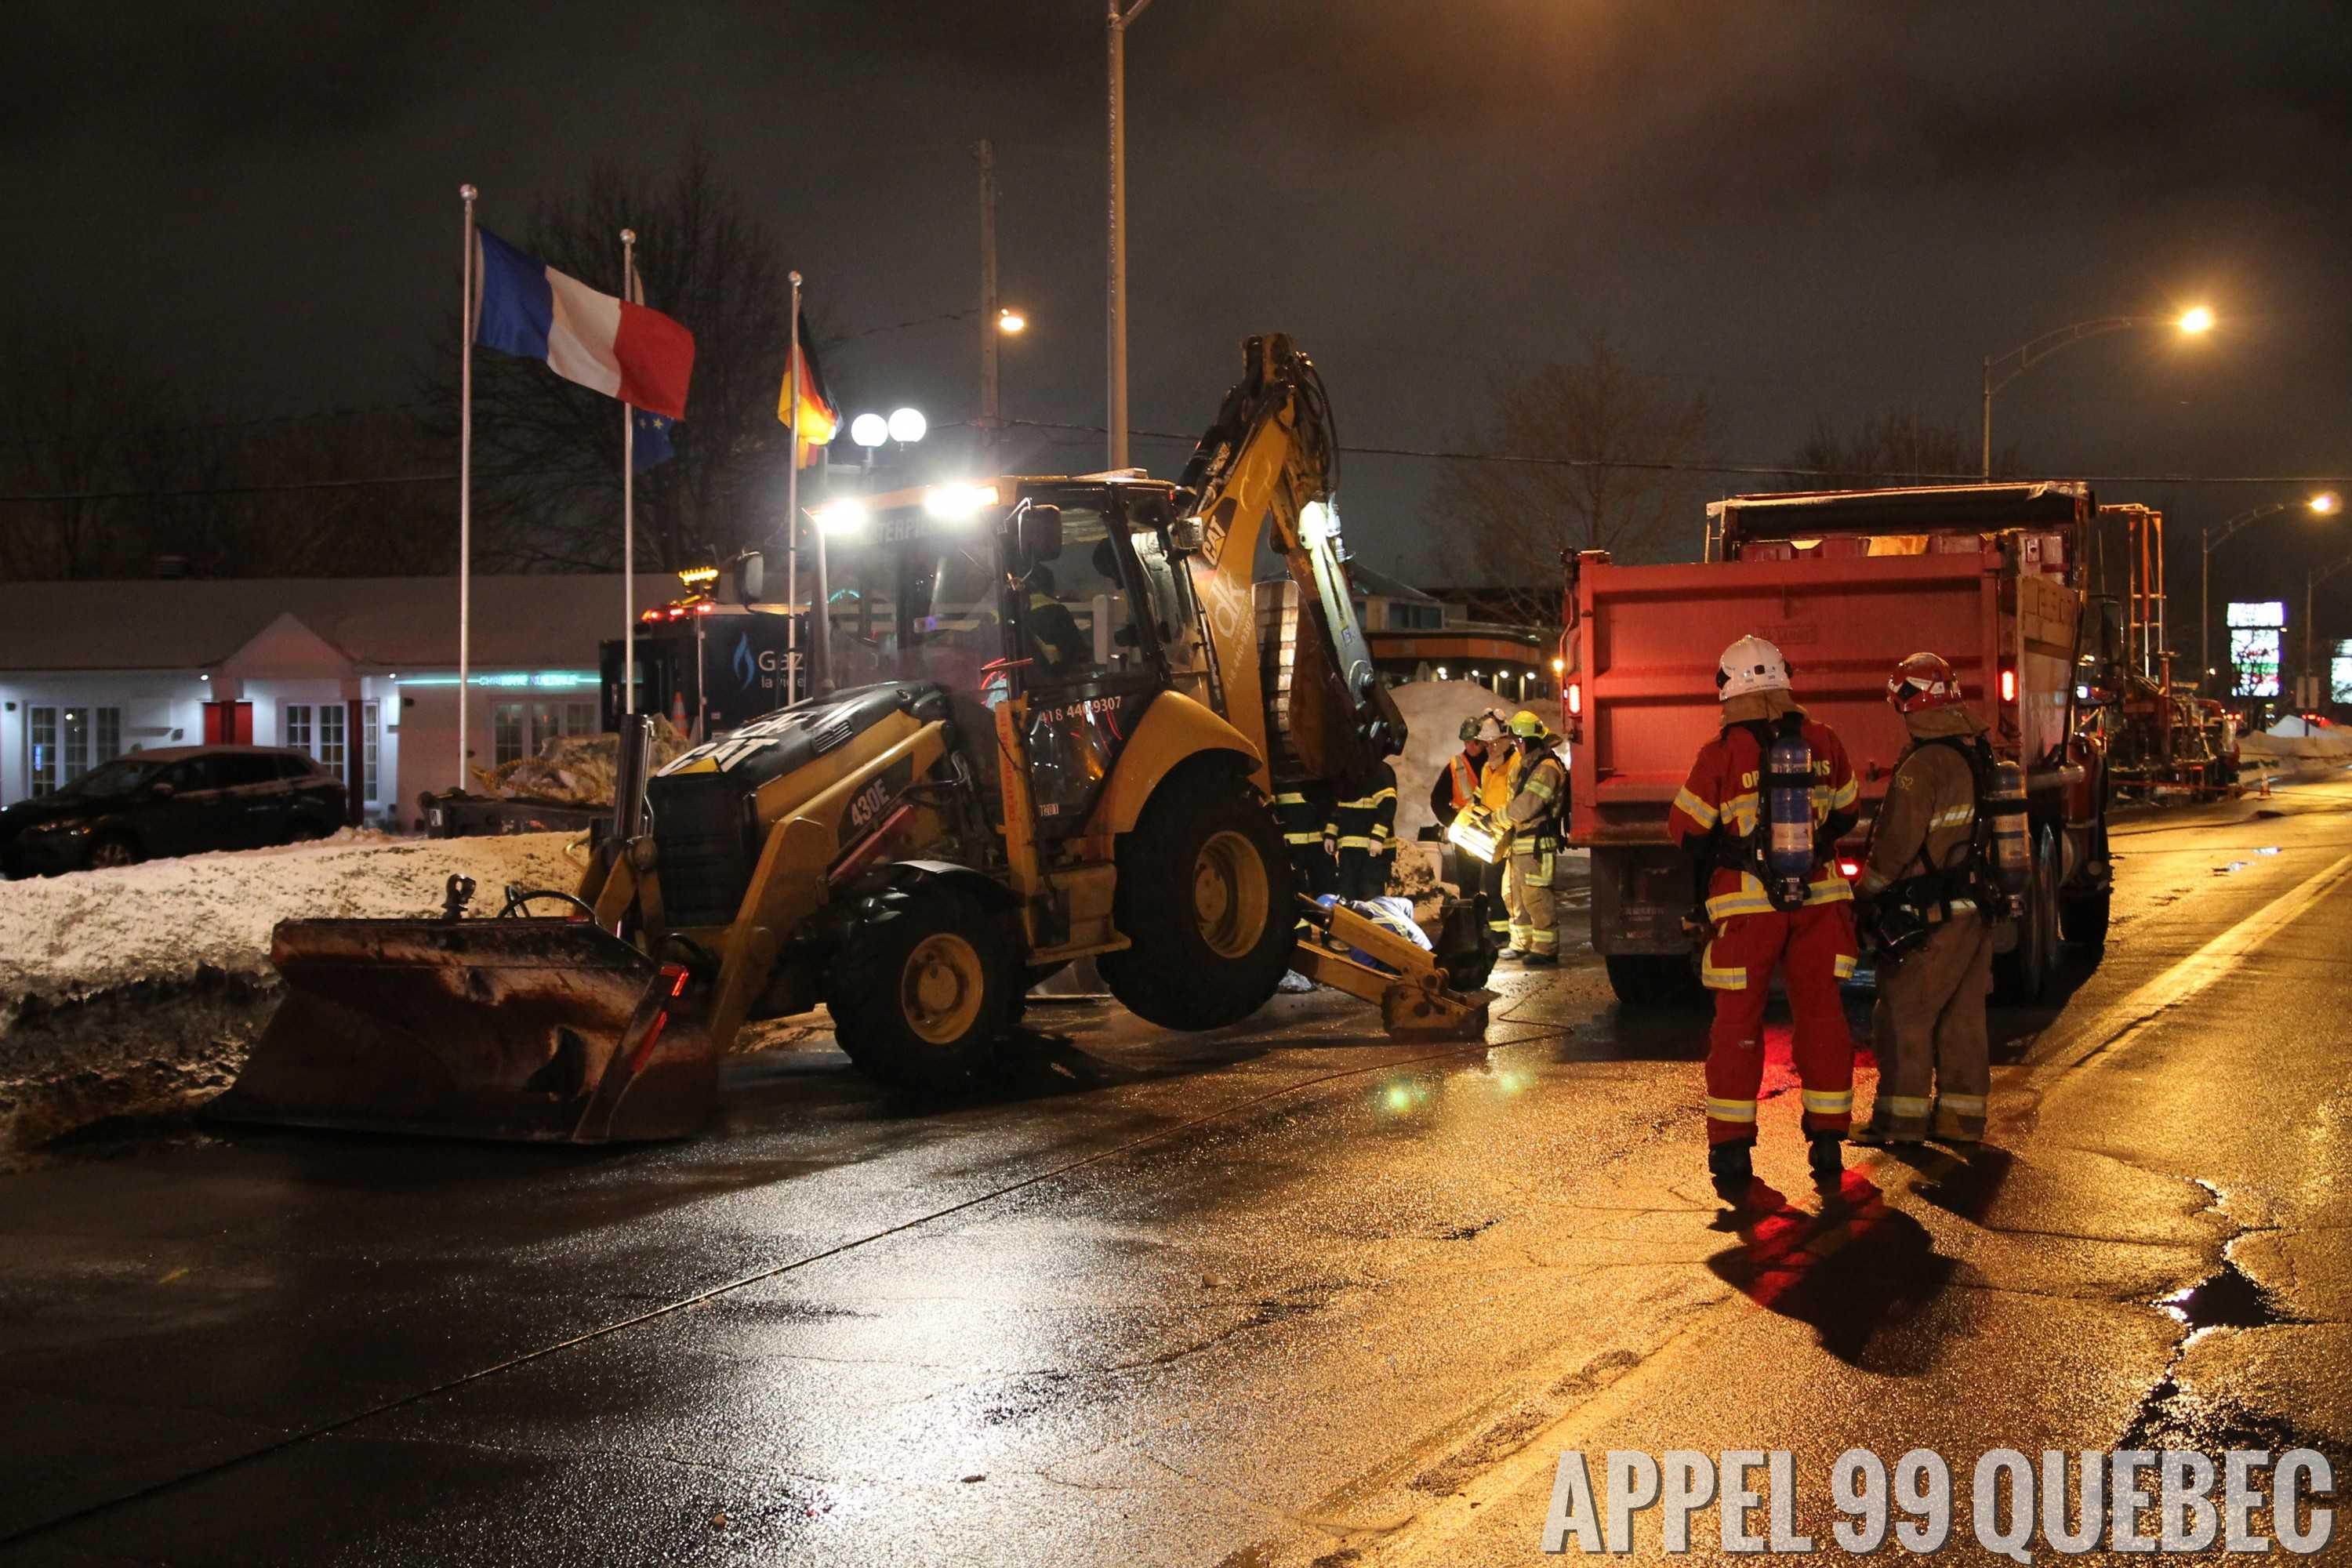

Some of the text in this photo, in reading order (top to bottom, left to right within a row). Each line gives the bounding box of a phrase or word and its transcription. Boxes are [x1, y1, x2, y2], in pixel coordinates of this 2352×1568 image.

[1203, 514, 1226, 565] CAT
[759, 651, 804, 671] Gaz
[1041, 708, 1063, 723] 418
[656, 739, 780, 777] CAT
[851, 778, 890, 826] 430E
